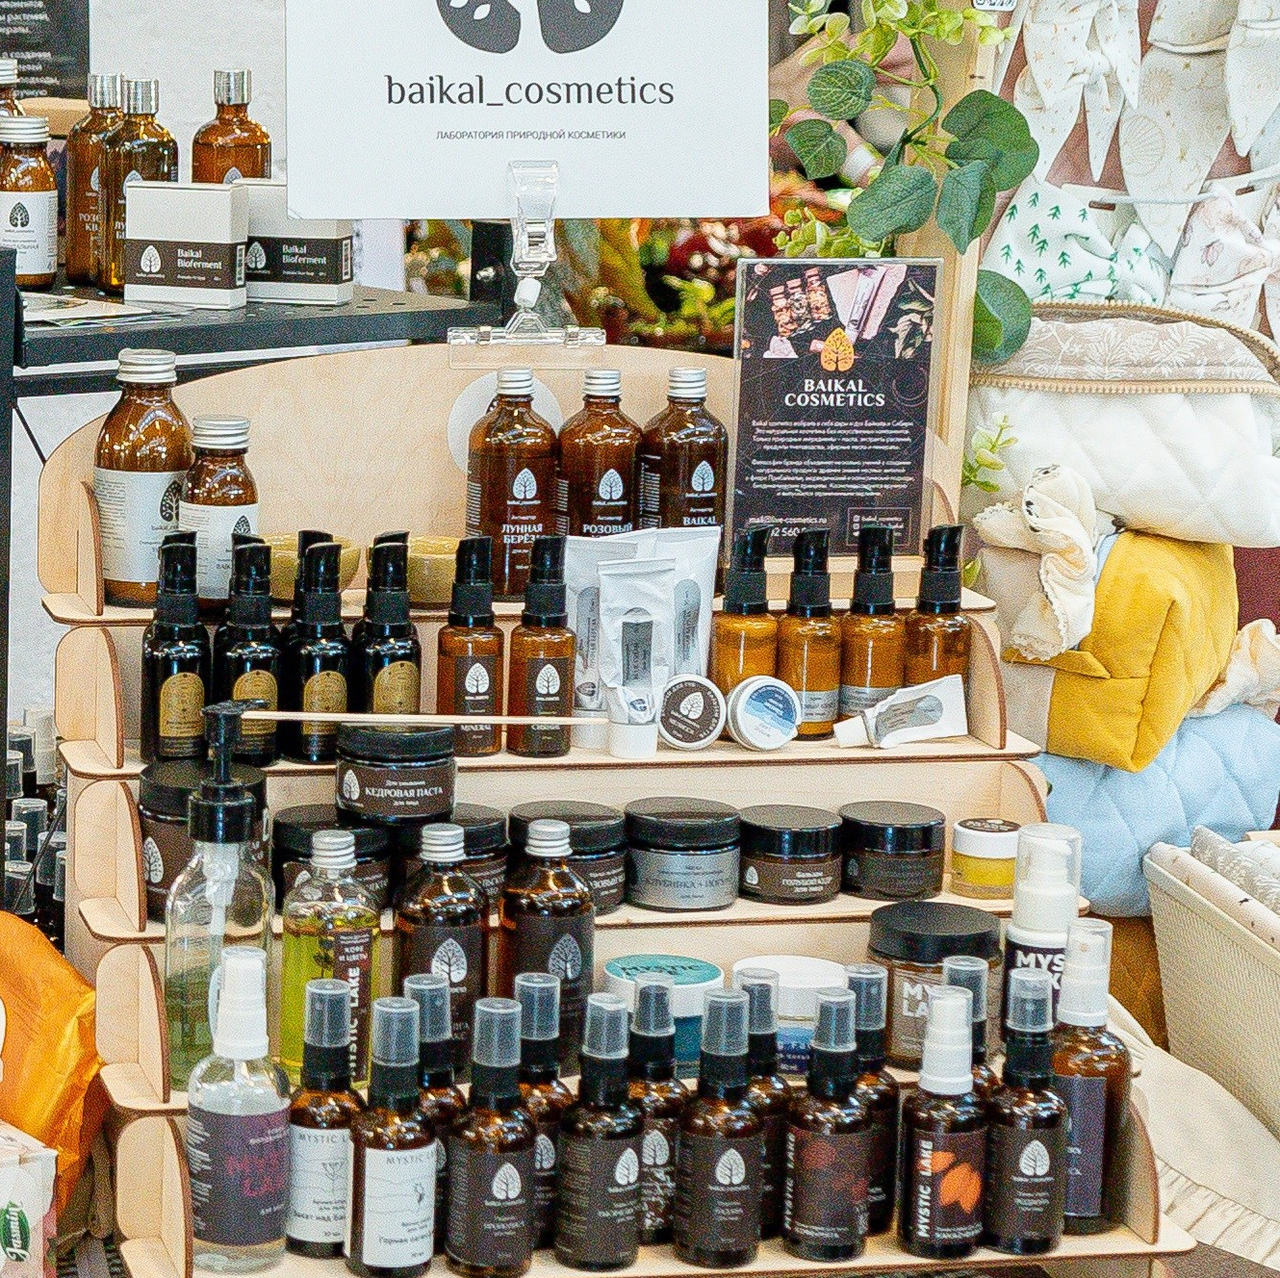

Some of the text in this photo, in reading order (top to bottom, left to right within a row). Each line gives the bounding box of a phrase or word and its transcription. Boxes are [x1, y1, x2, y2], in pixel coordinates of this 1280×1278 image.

[384, 74, 675, 108] baikal_cosmetics
[435, 128, 627, 142] ЛАБОРАТОРИЯ ПРИРОДНОЙ КОСМЕТИКИ
[177, 258, 223, 270] Bioferment
[804, 379, 867, 393] BAIKAL
[784, 393, 885, 407] COSMETICS
[501, 523, 544, 534] ЛУННАЯ
[582, 521, 634, 534] РОЗОВЫЙ
[365, 786, 443, 798] КЕДРОВАЯ ПАСТА
[1015, 950, 1066, 972] MYS
[349, 967, 360, 1008] LAKE
[298, 1133, 337, 1144] MYSTIC
[385, 1155, 418, 1165] MYSTIC
[917, 1139, 933, 1238] MYSTIC LAKE
[5, 1204, 30, 1261] Jasmin
